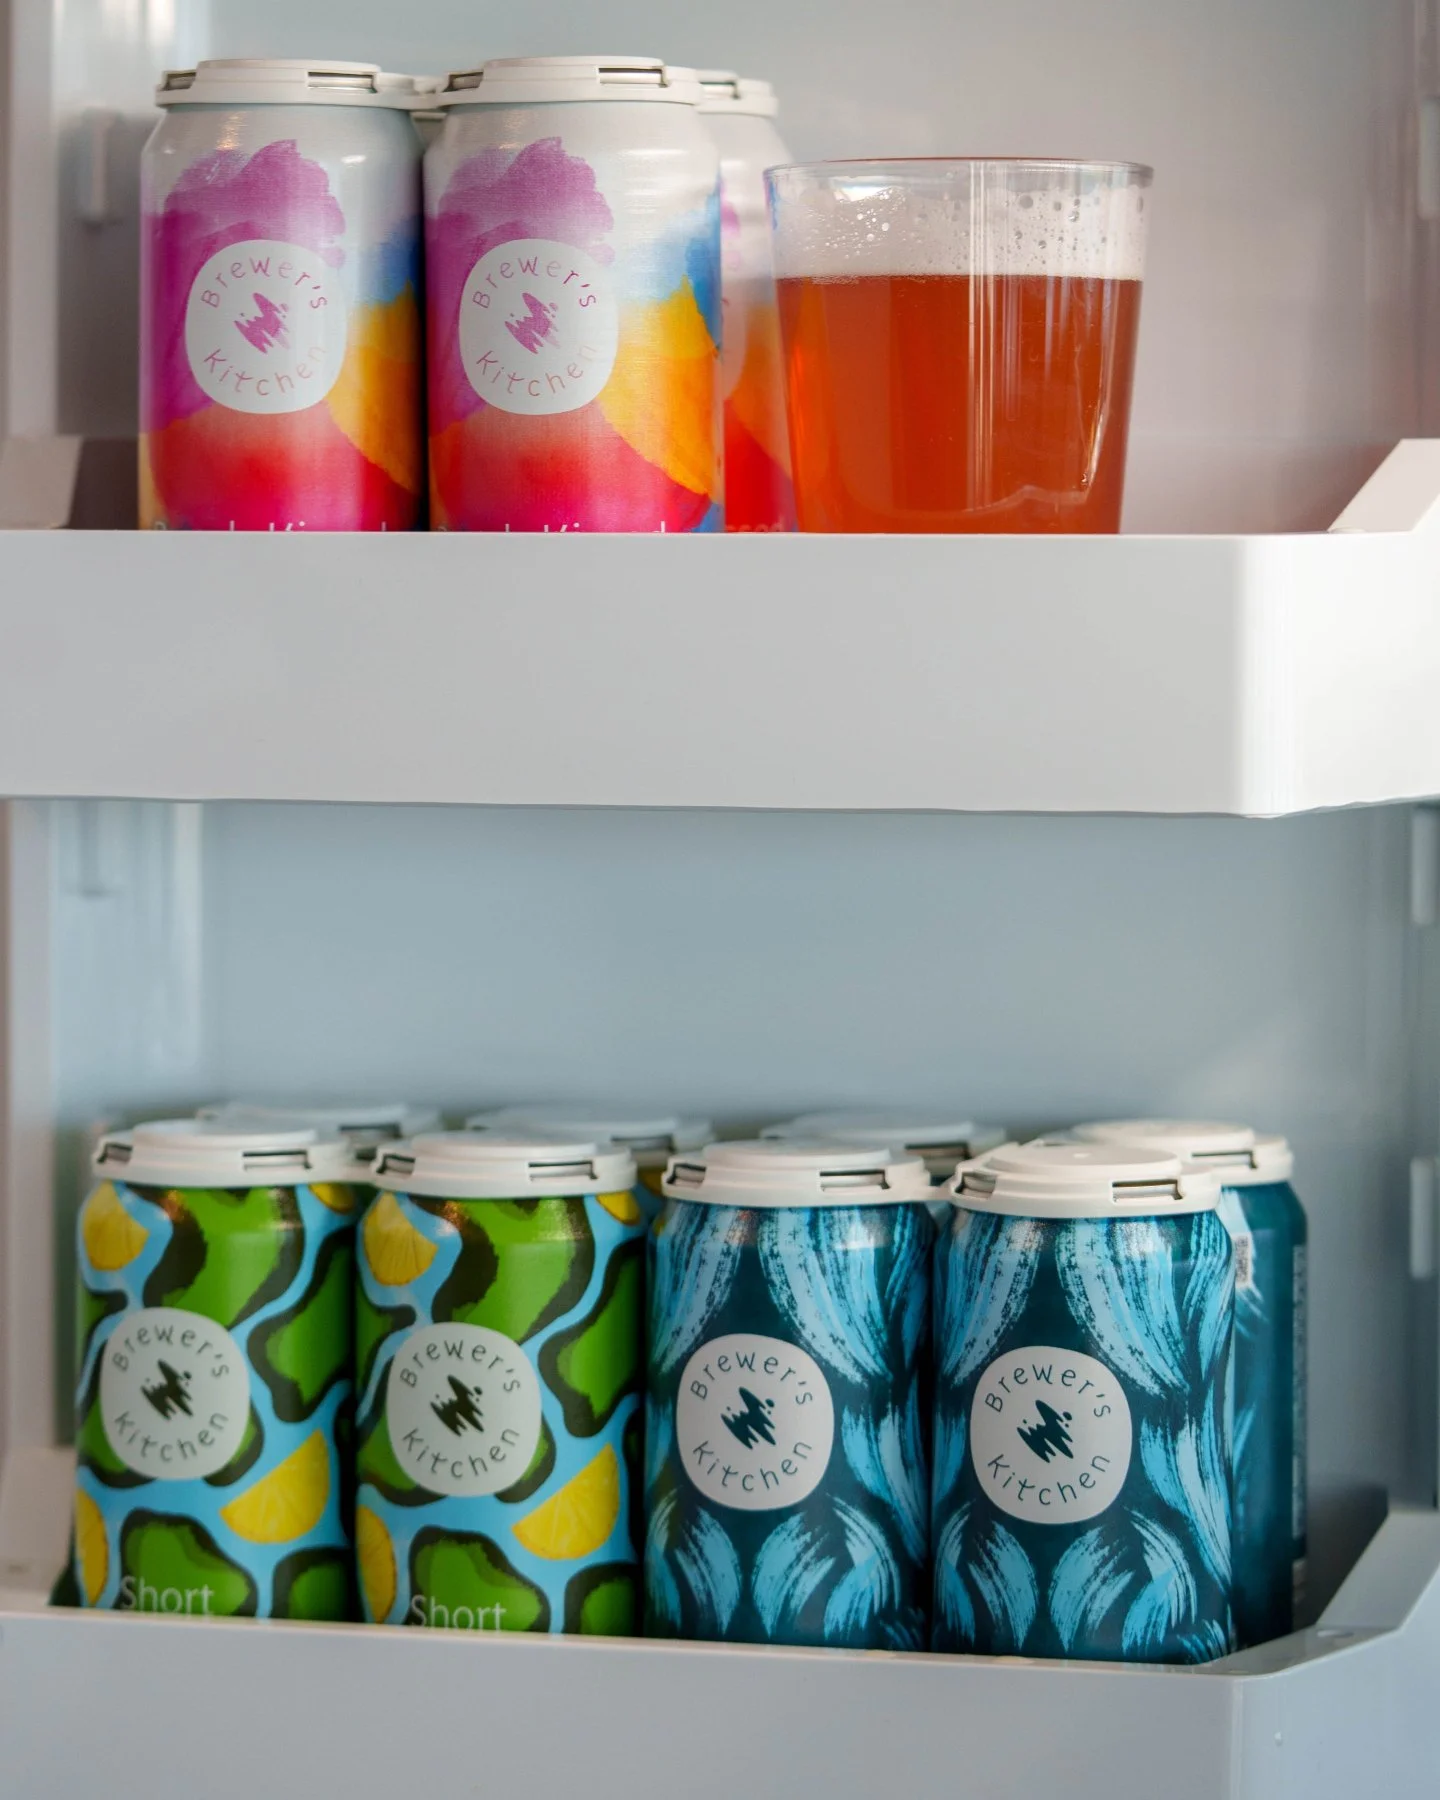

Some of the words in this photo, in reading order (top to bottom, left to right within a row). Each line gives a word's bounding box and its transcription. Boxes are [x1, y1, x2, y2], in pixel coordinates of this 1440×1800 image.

[201, 256, 327, 309] Brewer's
[472, 256, 597, 309] Brewer's
[203, 346, 328, 396] Kitchen
[475, 345, 597, 397] Kitchen
[112, 1324, 230, 1379] Brewer's
[400, 1339, 521, 1393] Brewer's
[690, 1351, 813, 1405] Brewer's
[985, 1364, 1111, 1418] Brewer's
[114, 1410, 229, 1463] Kitchen
[403, 1428, 520, 1478] Kitchen
[693, 1440, 812, 1492] Kitchen
[988, 1454, 1110, 1506] Kitchen
[120, 1575, 215, 1616] Short
[411, 1594, 508, 1630] Short
